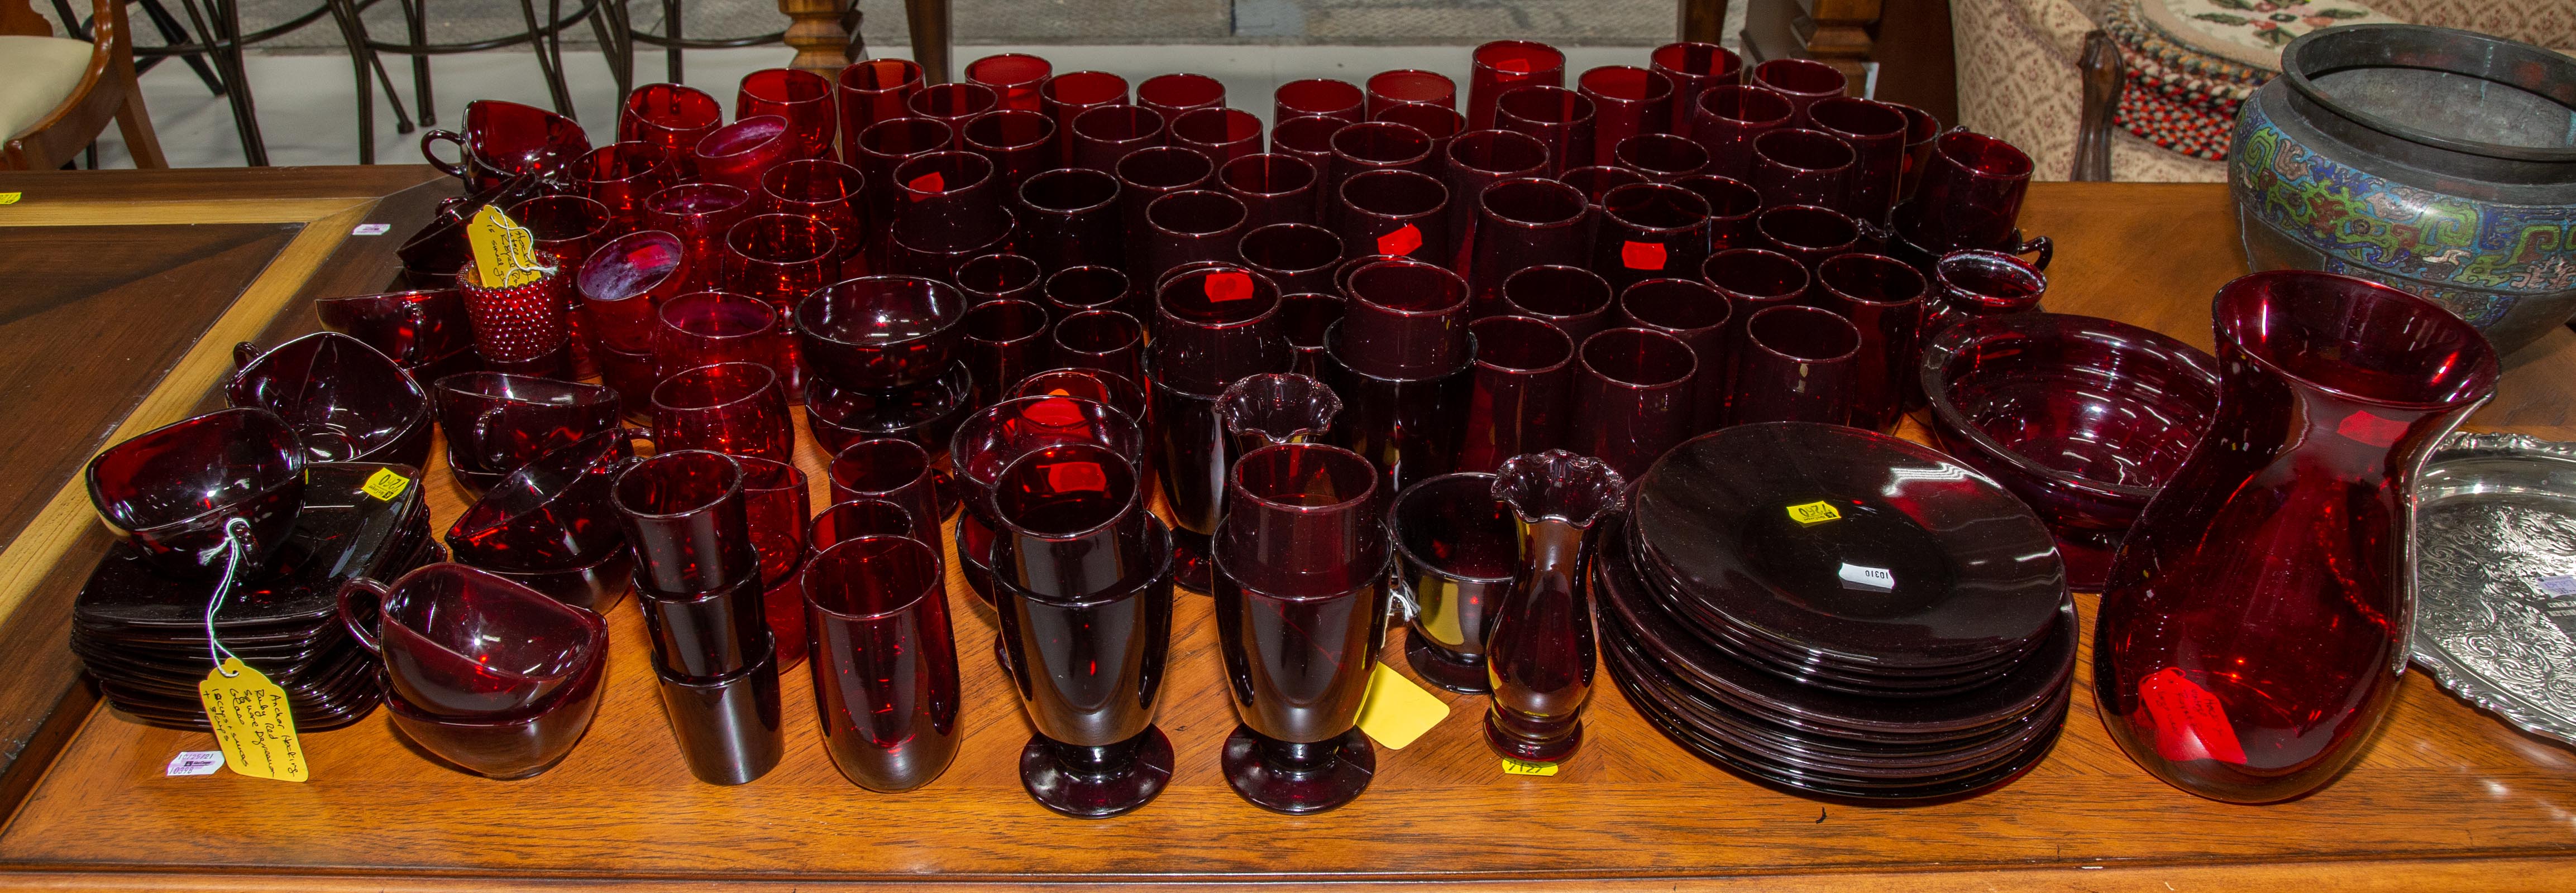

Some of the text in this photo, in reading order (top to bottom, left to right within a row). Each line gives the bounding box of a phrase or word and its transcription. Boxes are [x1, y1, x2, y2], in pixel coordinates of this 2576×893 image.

[1865, 570, 1889, 579] 10310
[255, 689, 278, 740] Ruby Red
